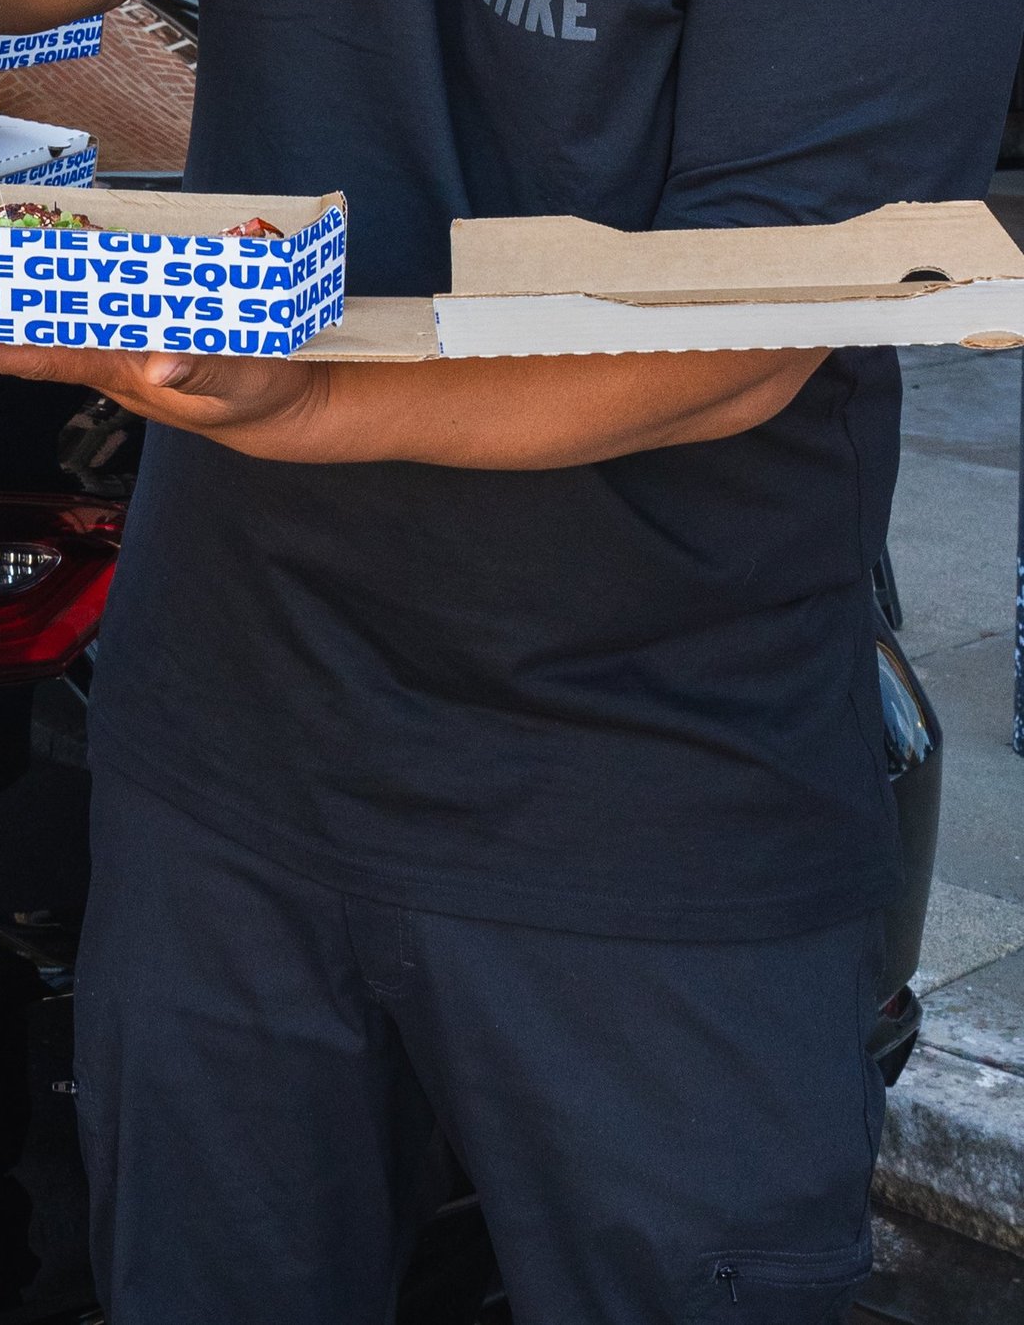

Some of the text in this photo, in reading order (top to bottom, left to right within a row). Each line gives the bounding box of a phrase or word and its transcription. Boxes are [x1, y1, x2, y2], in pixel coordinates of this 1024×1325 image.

[14, 32, 58, 53] GUYS
[34, 43, 101, 66] SQUARE
[29, 159, 64, 180] GUYS
[10, 229, 88, 251] PIE
[98, 232, 225, 258] GUYS
[239, 207, 343, 263] SQUARE
[24, 255, 149, 285] GUYS
[163, 249, 317, 293] SQUARE
[321, 230, 345, 270] PIE
[11, 288, 88, 316] PIE
[98, 292, 224, 321] GUYS
[238, 264, 342, 329] SQUARE
[25, 319, 149, 348] GUYS
[163, 314, 316, 355] SQUARE
[319, 294, 344, 331] PIE
